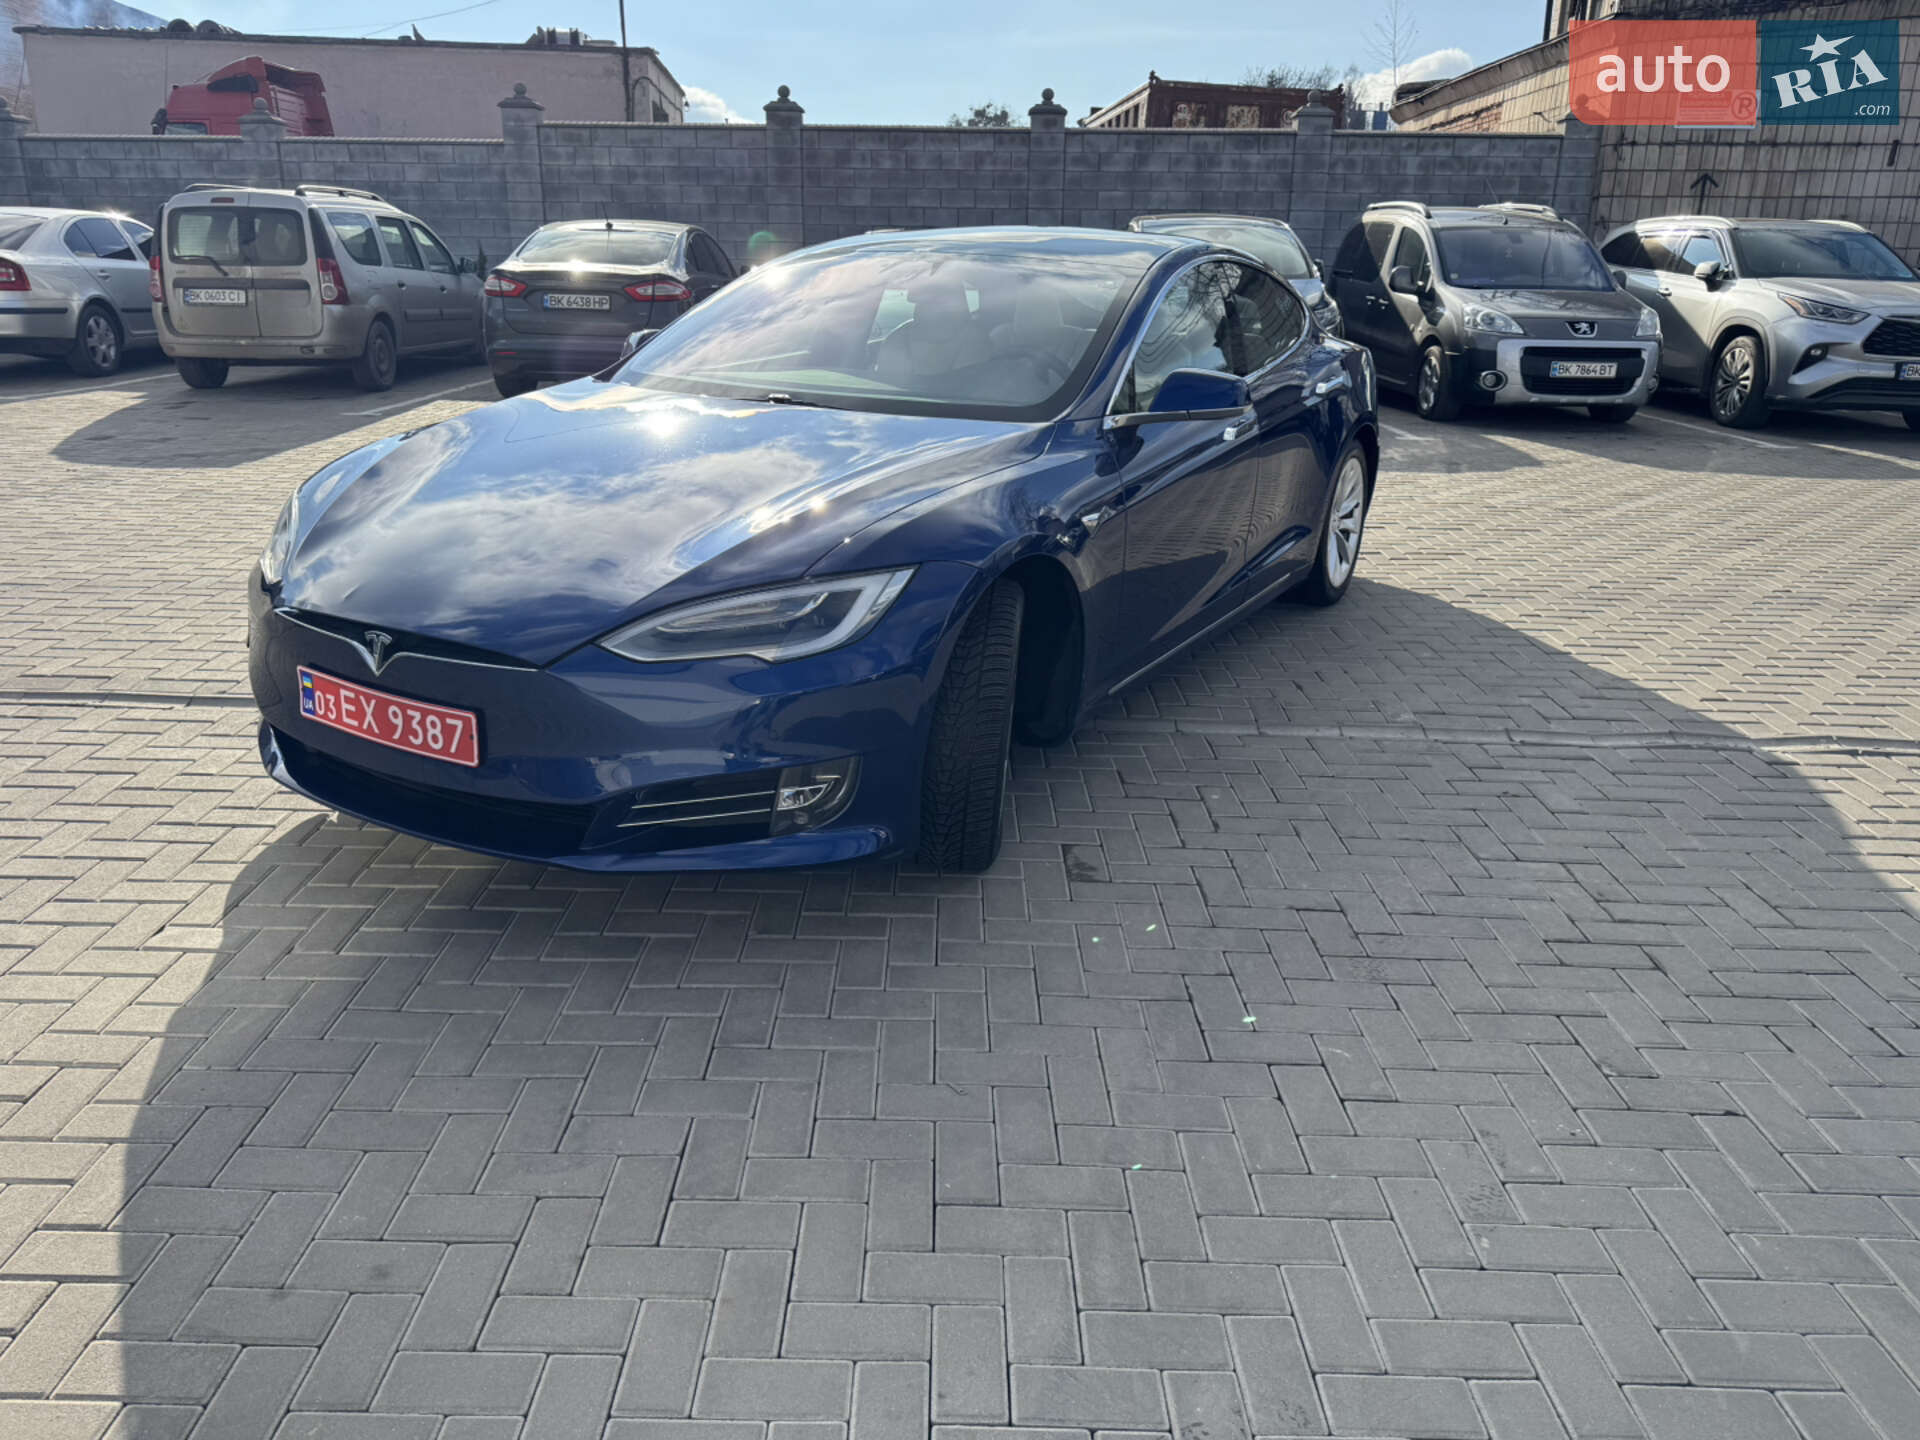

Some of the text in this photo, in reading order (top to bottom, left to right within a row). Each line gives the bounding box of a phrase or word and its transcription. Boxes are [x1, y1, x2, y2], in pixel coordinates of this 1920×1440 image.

[204, 290, 227, 301] 0603
[549, 295, 609, 308] BK 6438 HP
[1558, 364, 1614, 376] BK 7864 BT
[303, 696, 315, 712] UA
[339, 688, 380, 735] EX
[387, 704, 464, 754] 9387
